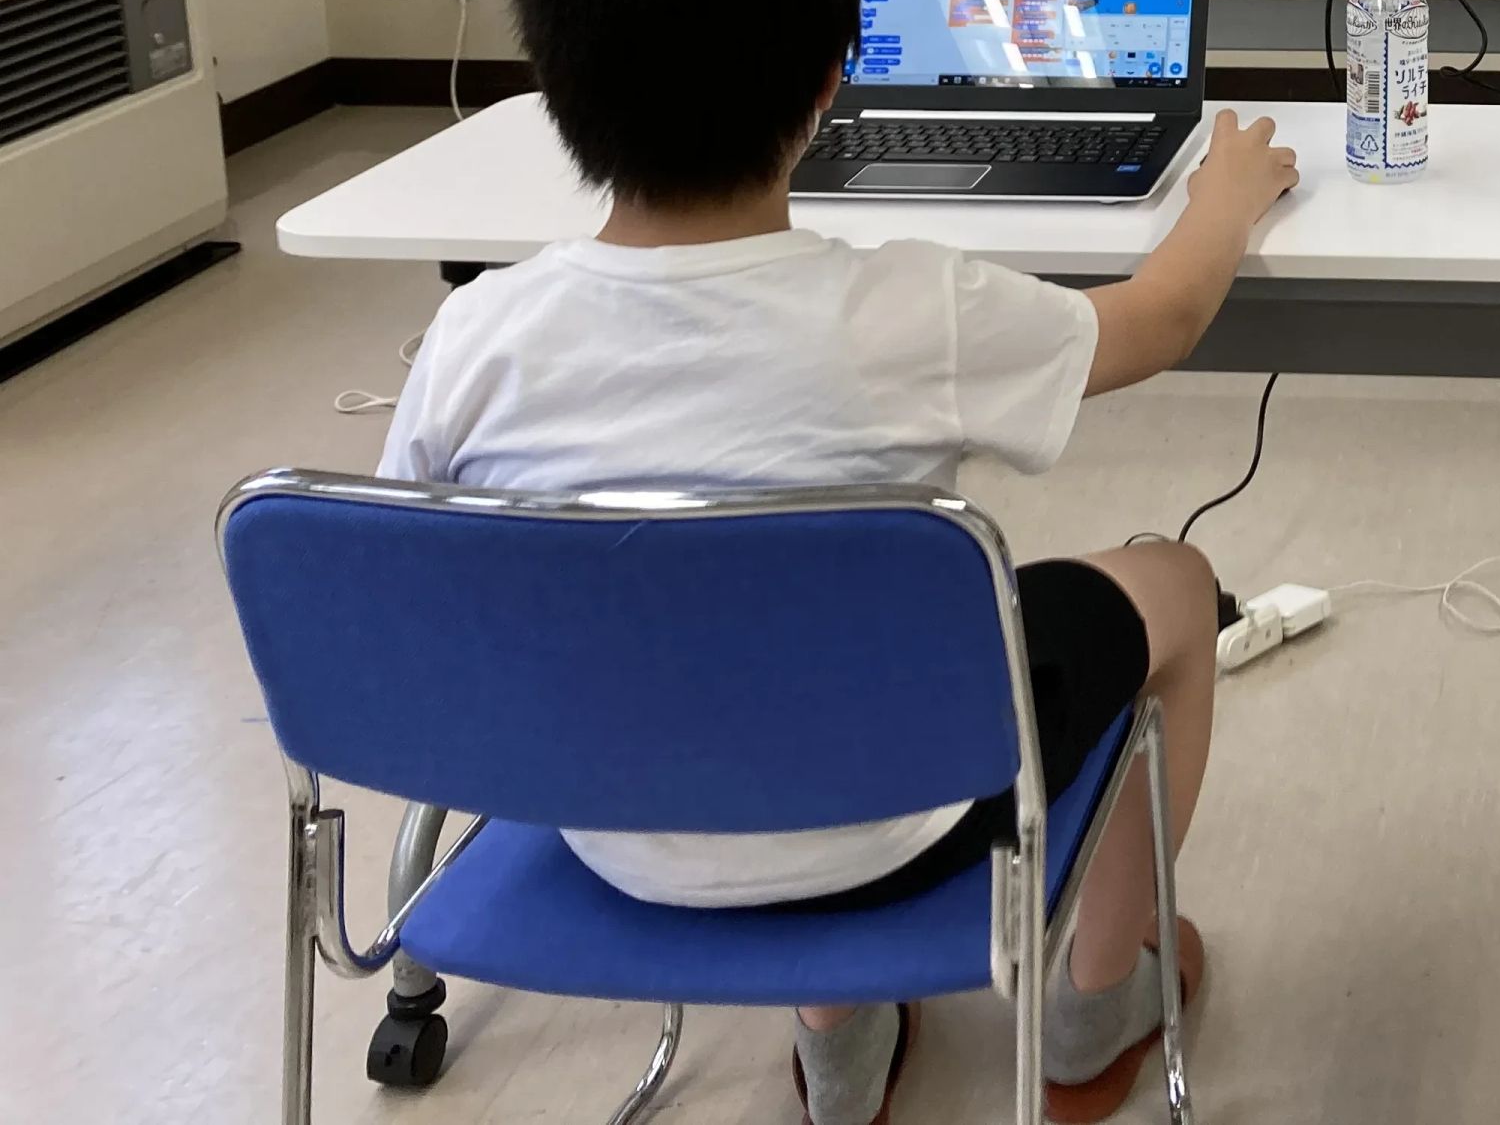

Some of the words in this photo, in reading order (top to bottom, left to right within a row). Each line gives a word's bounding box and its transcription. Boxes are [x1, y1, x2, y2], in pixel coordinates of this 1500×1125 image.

[1395, 65, 1428, 84] ソルテ
[1402, 79, 1427, 100] ライチ
